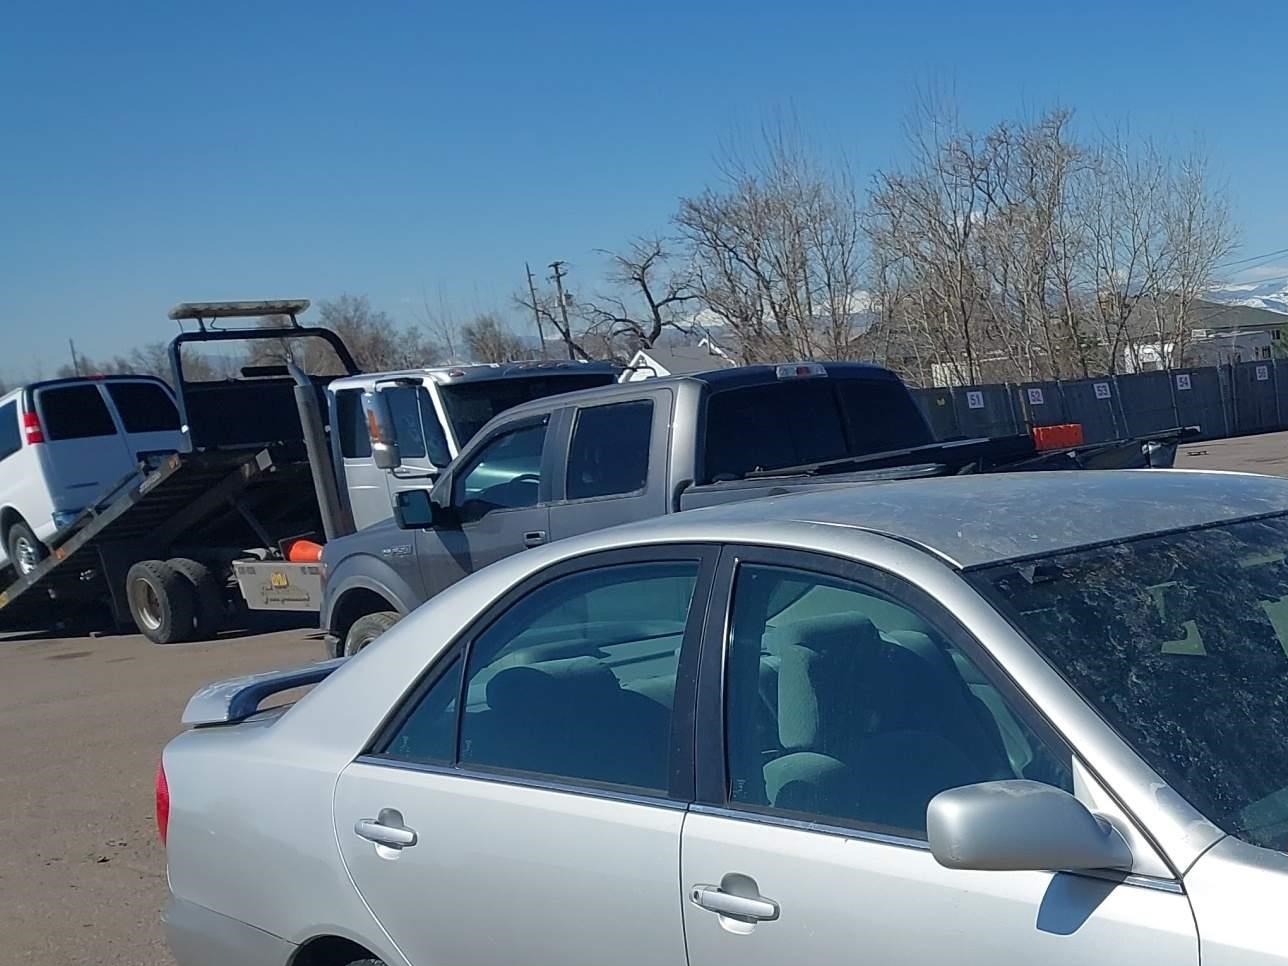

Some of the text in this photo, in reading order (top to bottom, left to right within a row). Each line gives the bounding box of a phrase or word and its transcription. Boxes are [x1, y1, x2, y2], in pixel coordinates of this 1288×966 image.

[1178, 375, 1189, 388] 54
[1030, 390, 1042, 402] 52
[1096, 385, 1108, 397] 53
[969, 393, 982, 406] 51
